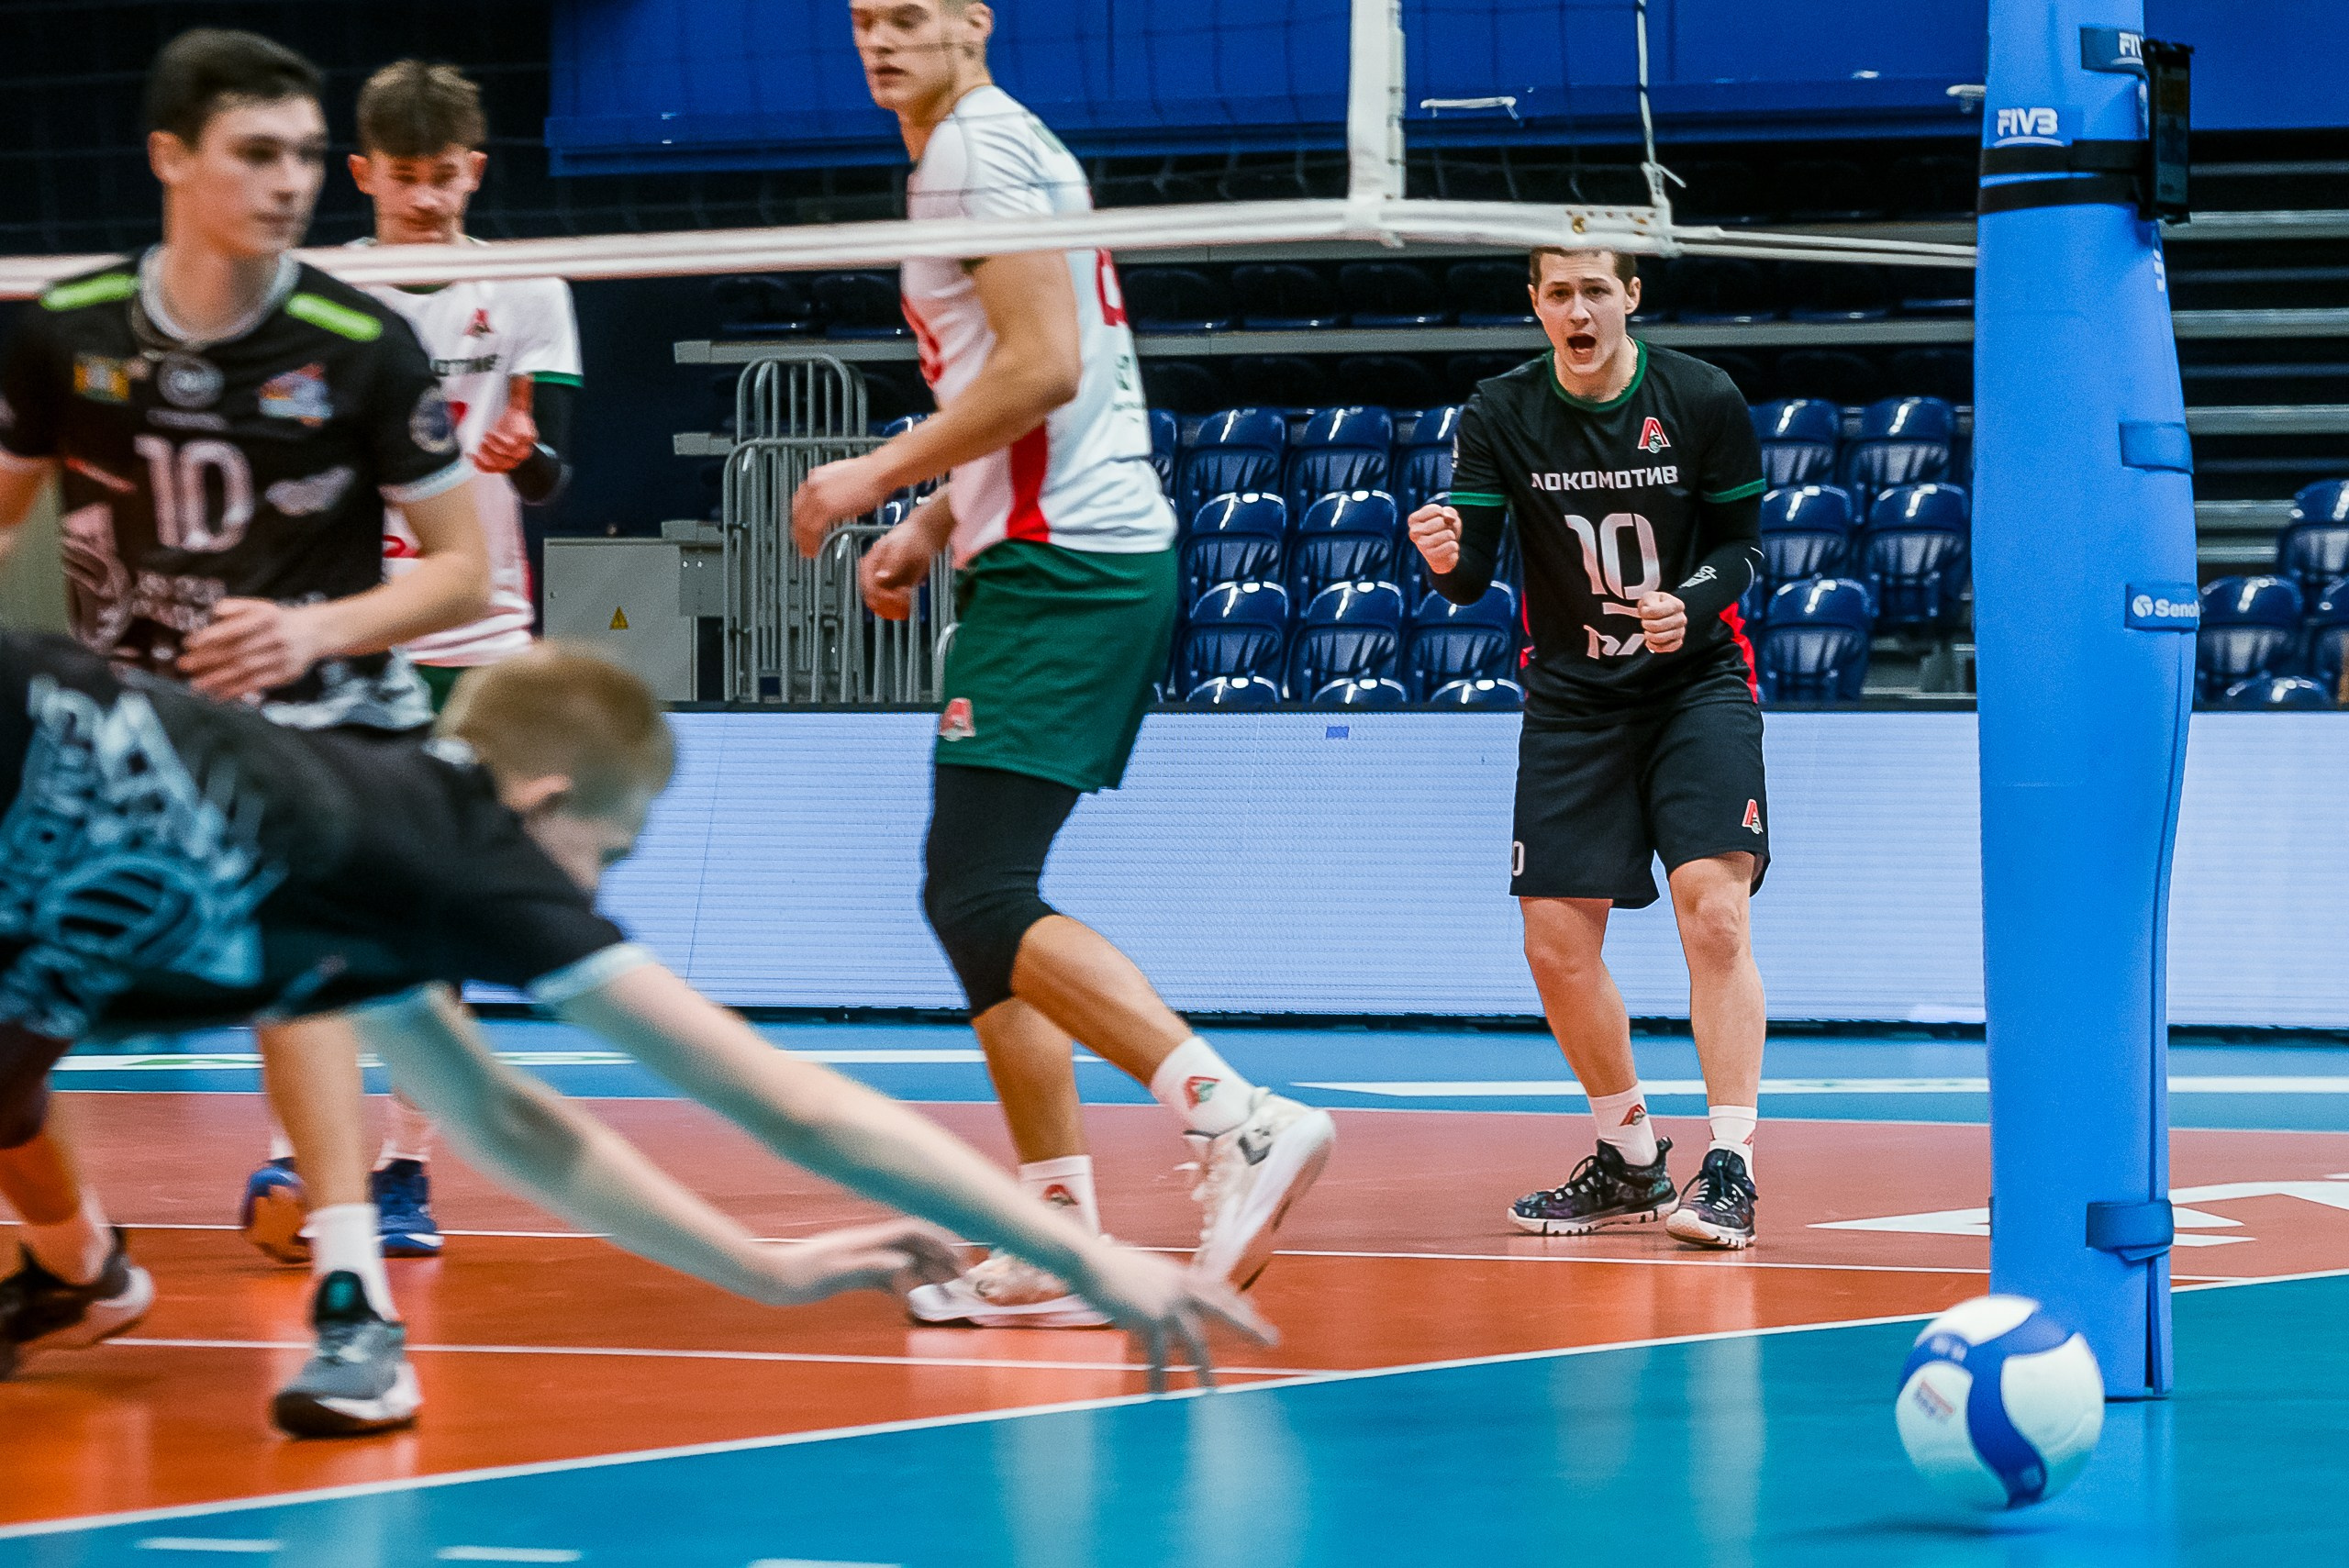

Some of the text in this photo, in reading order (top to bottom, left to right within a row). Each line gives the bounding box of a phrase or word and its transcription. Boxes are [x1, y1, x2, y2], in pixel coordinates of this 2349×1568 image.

[2119, 31, 2144, 59] FIV
[1997, 106, 2059, 137] FIVB
[133, 432, 256, 551] 10
[1531, 465, 1678, 491] ЛОКОМОТИВ
[1564, 513, 1662, 601] 10
